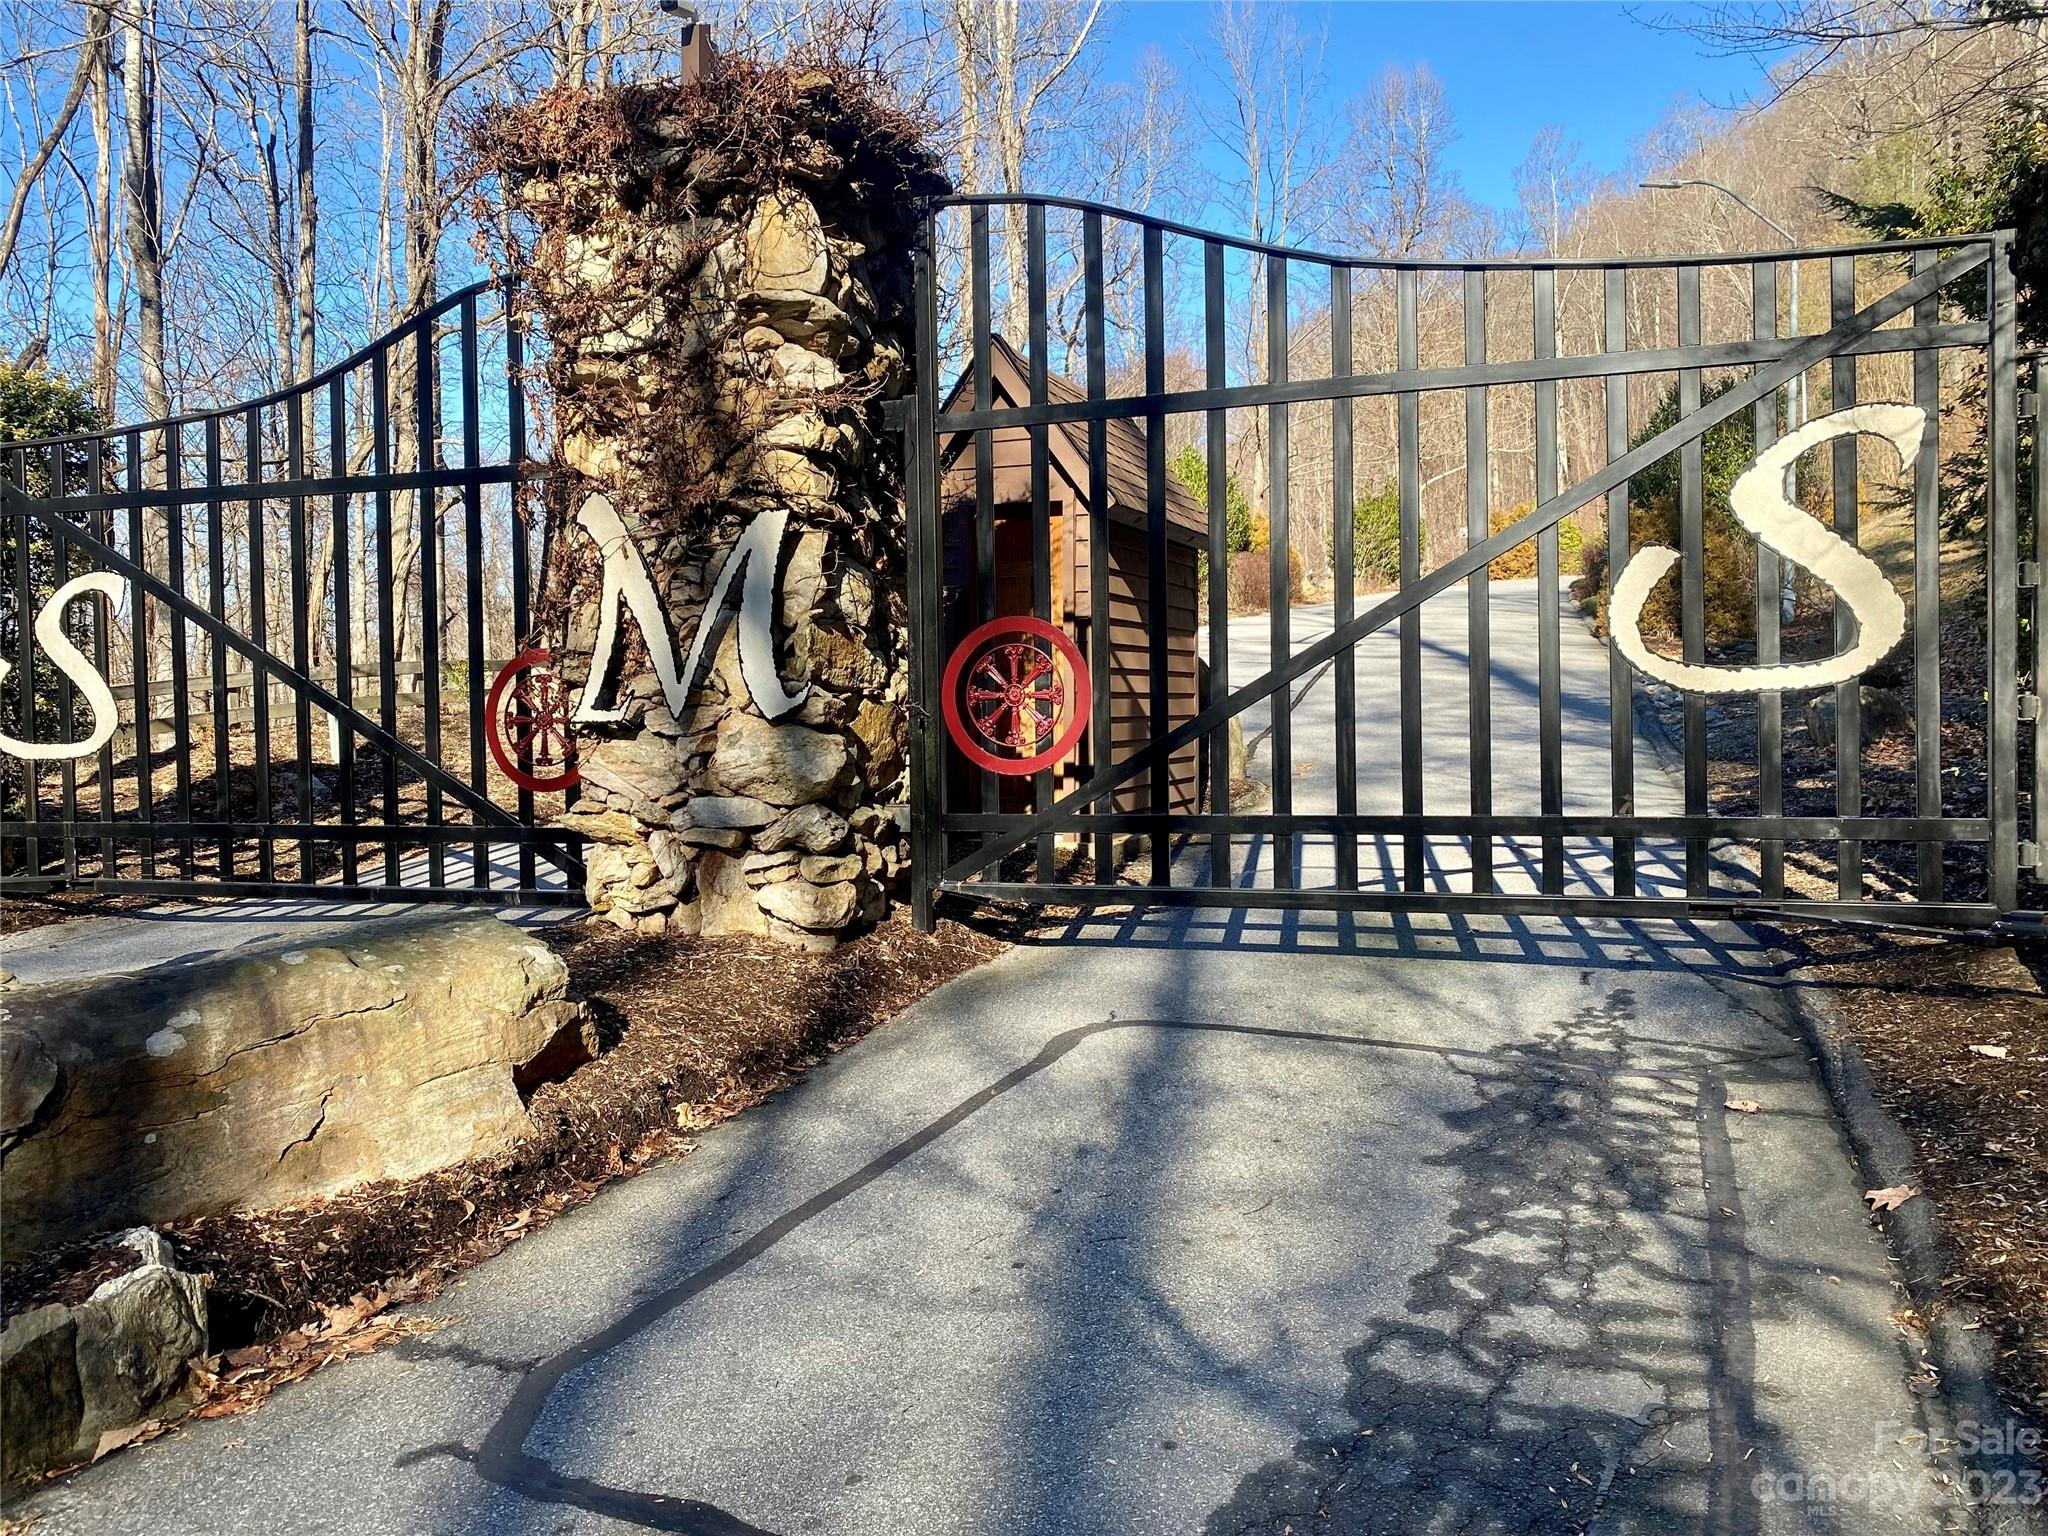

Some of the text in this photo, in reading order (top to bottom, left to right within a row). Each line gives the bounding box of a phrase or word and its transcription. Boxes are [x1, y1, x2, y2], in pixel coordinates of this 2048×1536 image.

[570, 491, 812, 722] M
[1607, 401, 1929, 694] S
[0, 571, 125, 760] S
